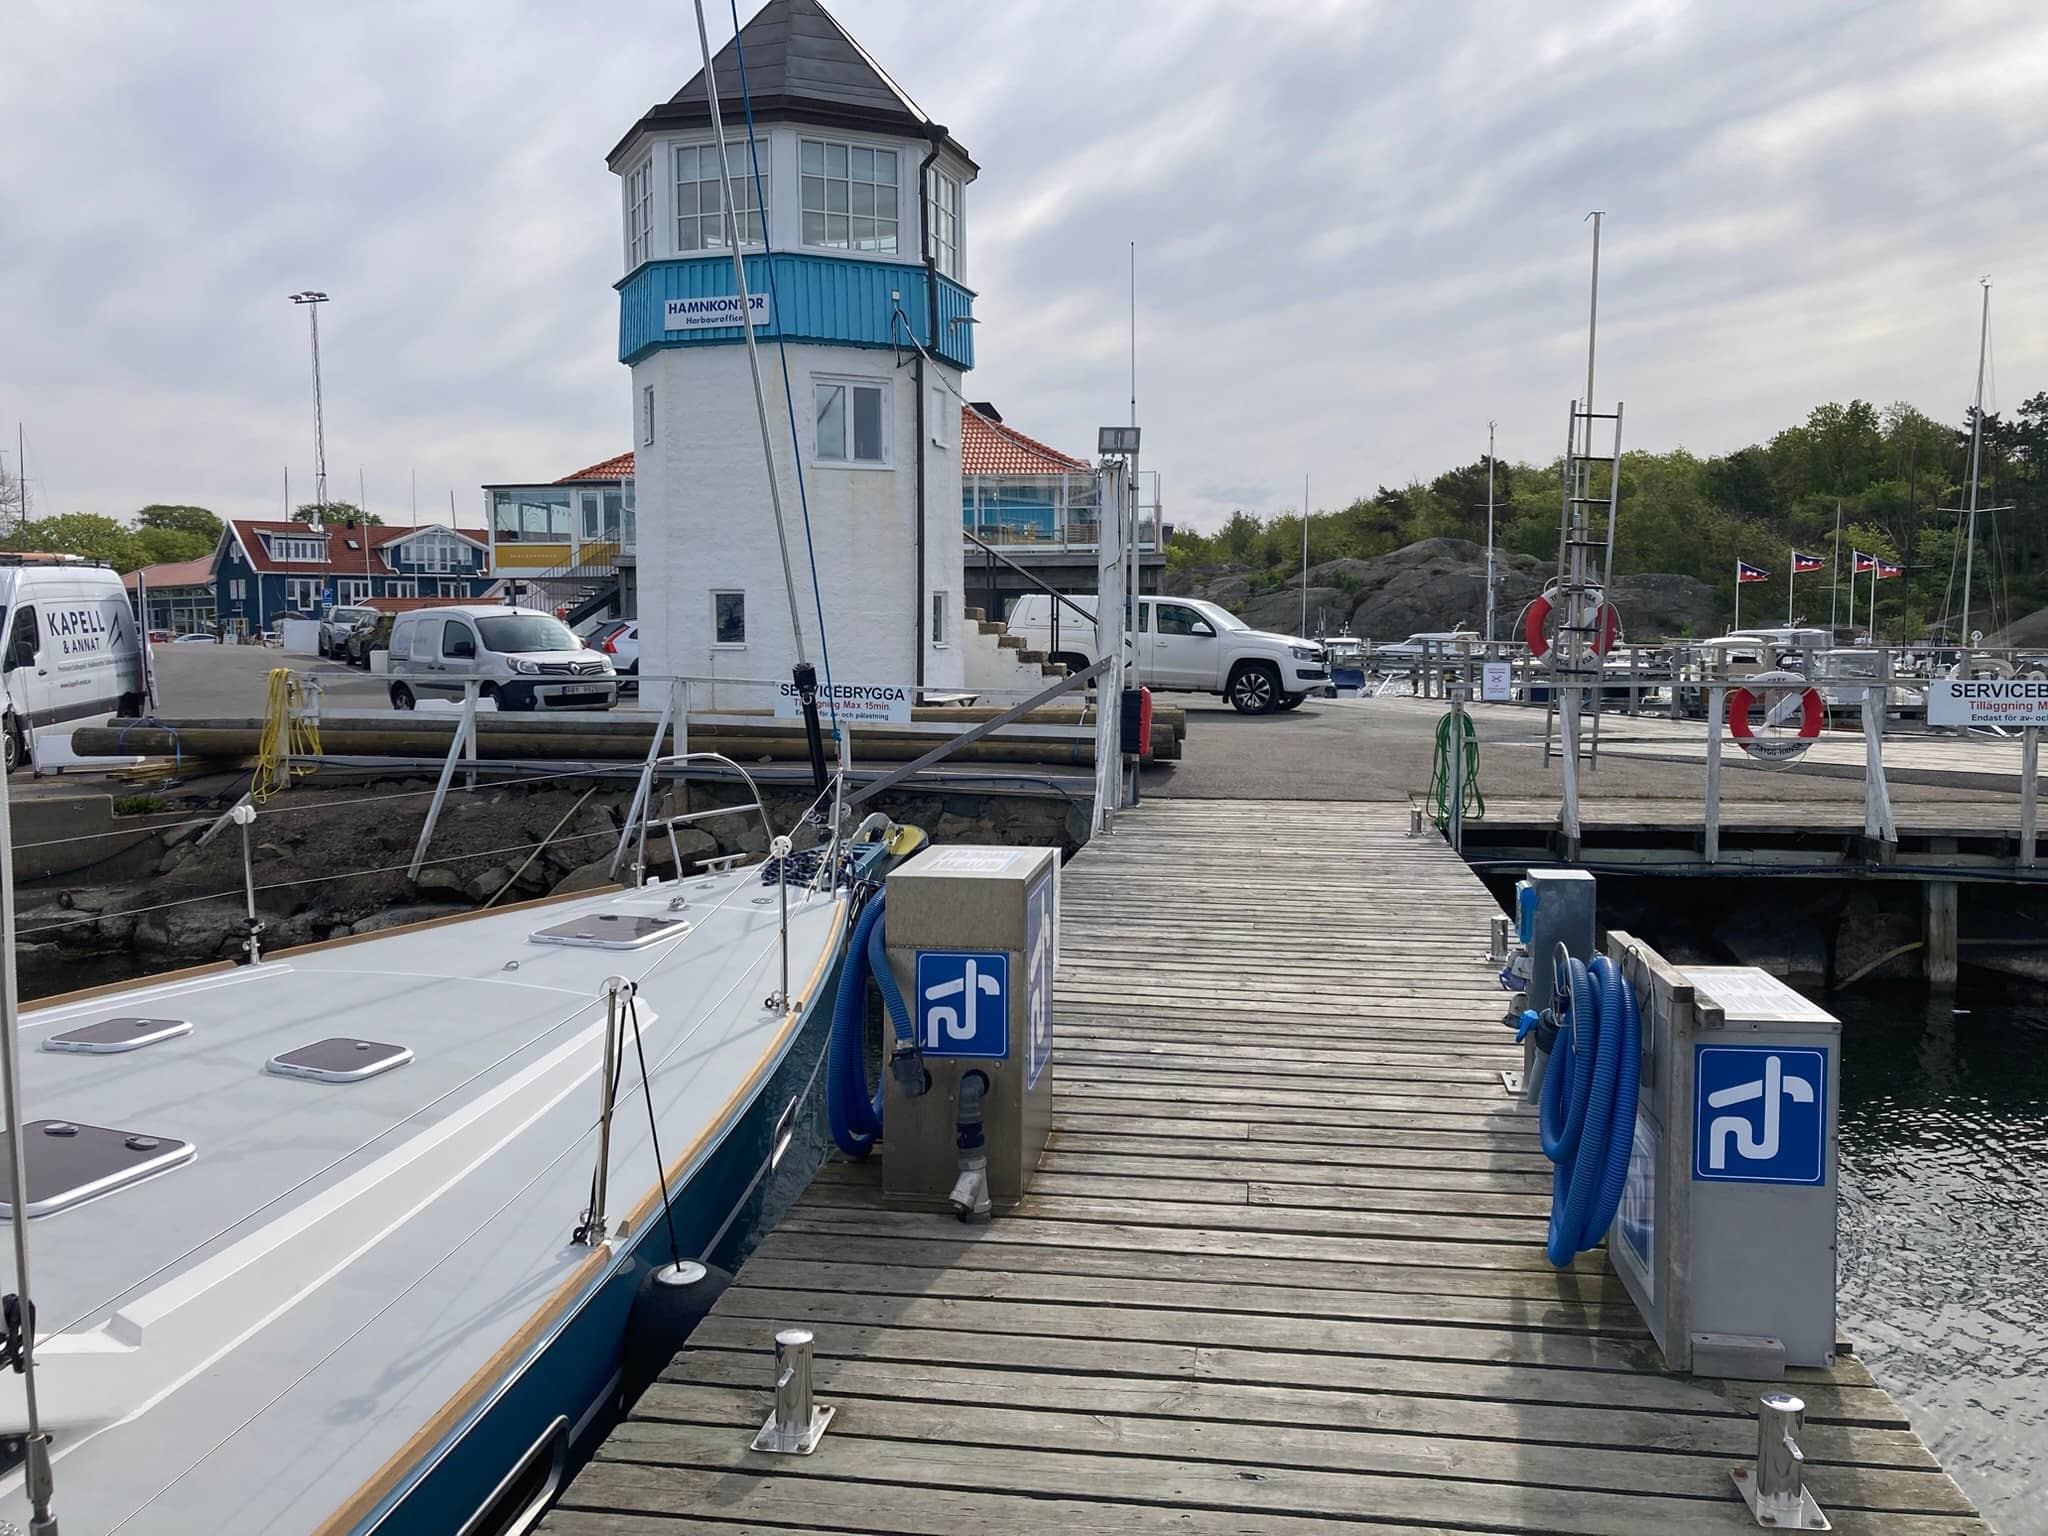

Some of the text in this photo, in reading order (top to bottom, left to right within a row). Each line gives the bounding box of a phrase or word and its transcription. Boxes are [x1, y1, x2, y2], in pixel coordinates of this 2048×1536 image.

[46, 610, 105, 637] KAPELL
[63, 637, 100, 654] & ANNAT
[780, 683, 905, 701] SEICEBRYGGA
[843, 700, 861, 709] Max
[1968, 701, 2033, 712] Tilläggning
[1971, 713, 2001, 722] Endast
[2004, 713, 2017, 721] för
